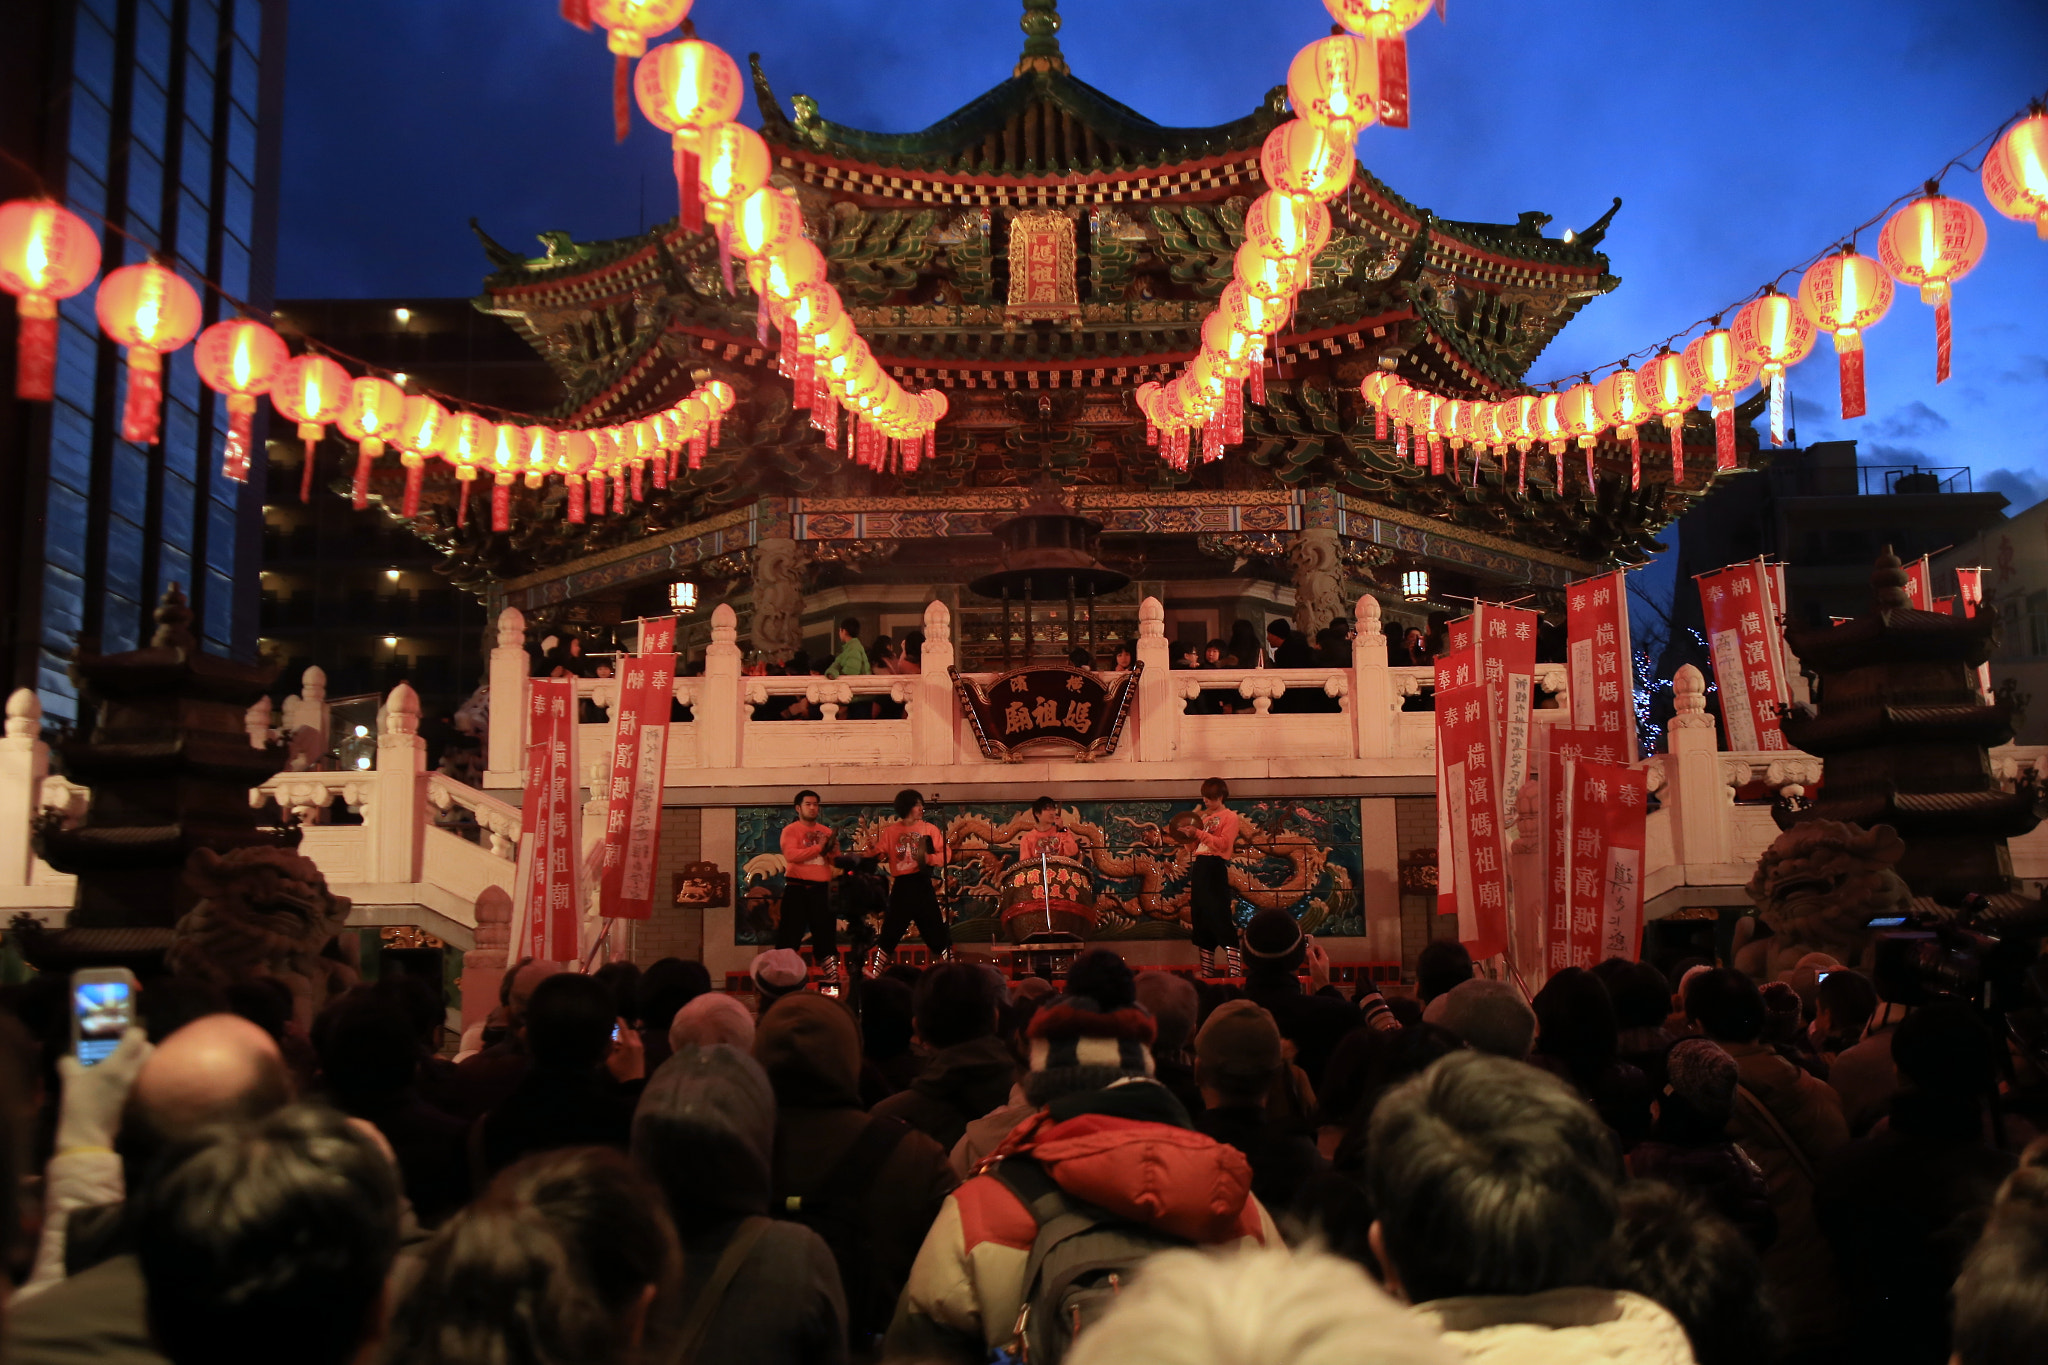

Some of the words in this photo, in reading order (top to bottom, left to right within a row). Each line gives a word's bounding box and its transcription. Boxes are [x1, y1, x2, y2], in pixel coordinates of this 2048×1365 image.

[1029, 244, 1056, 303] 媽祖廟
[1571, 587, 1610, 612] 奉納
[1706, 577, 1751, 602] 奉納
[1438, 663, 1469, 690] 奉納
[1595, 622, 1620, 733] 横濱媽祖
[1740, 611, 1784, 750] 横濱媽祖廟
[1004, 695, 1093, 735] 媽祖廟
[1444, 699, 1481, 729] 奉納
[1466, 742, 1503, 909] 横濱媽祖廟
